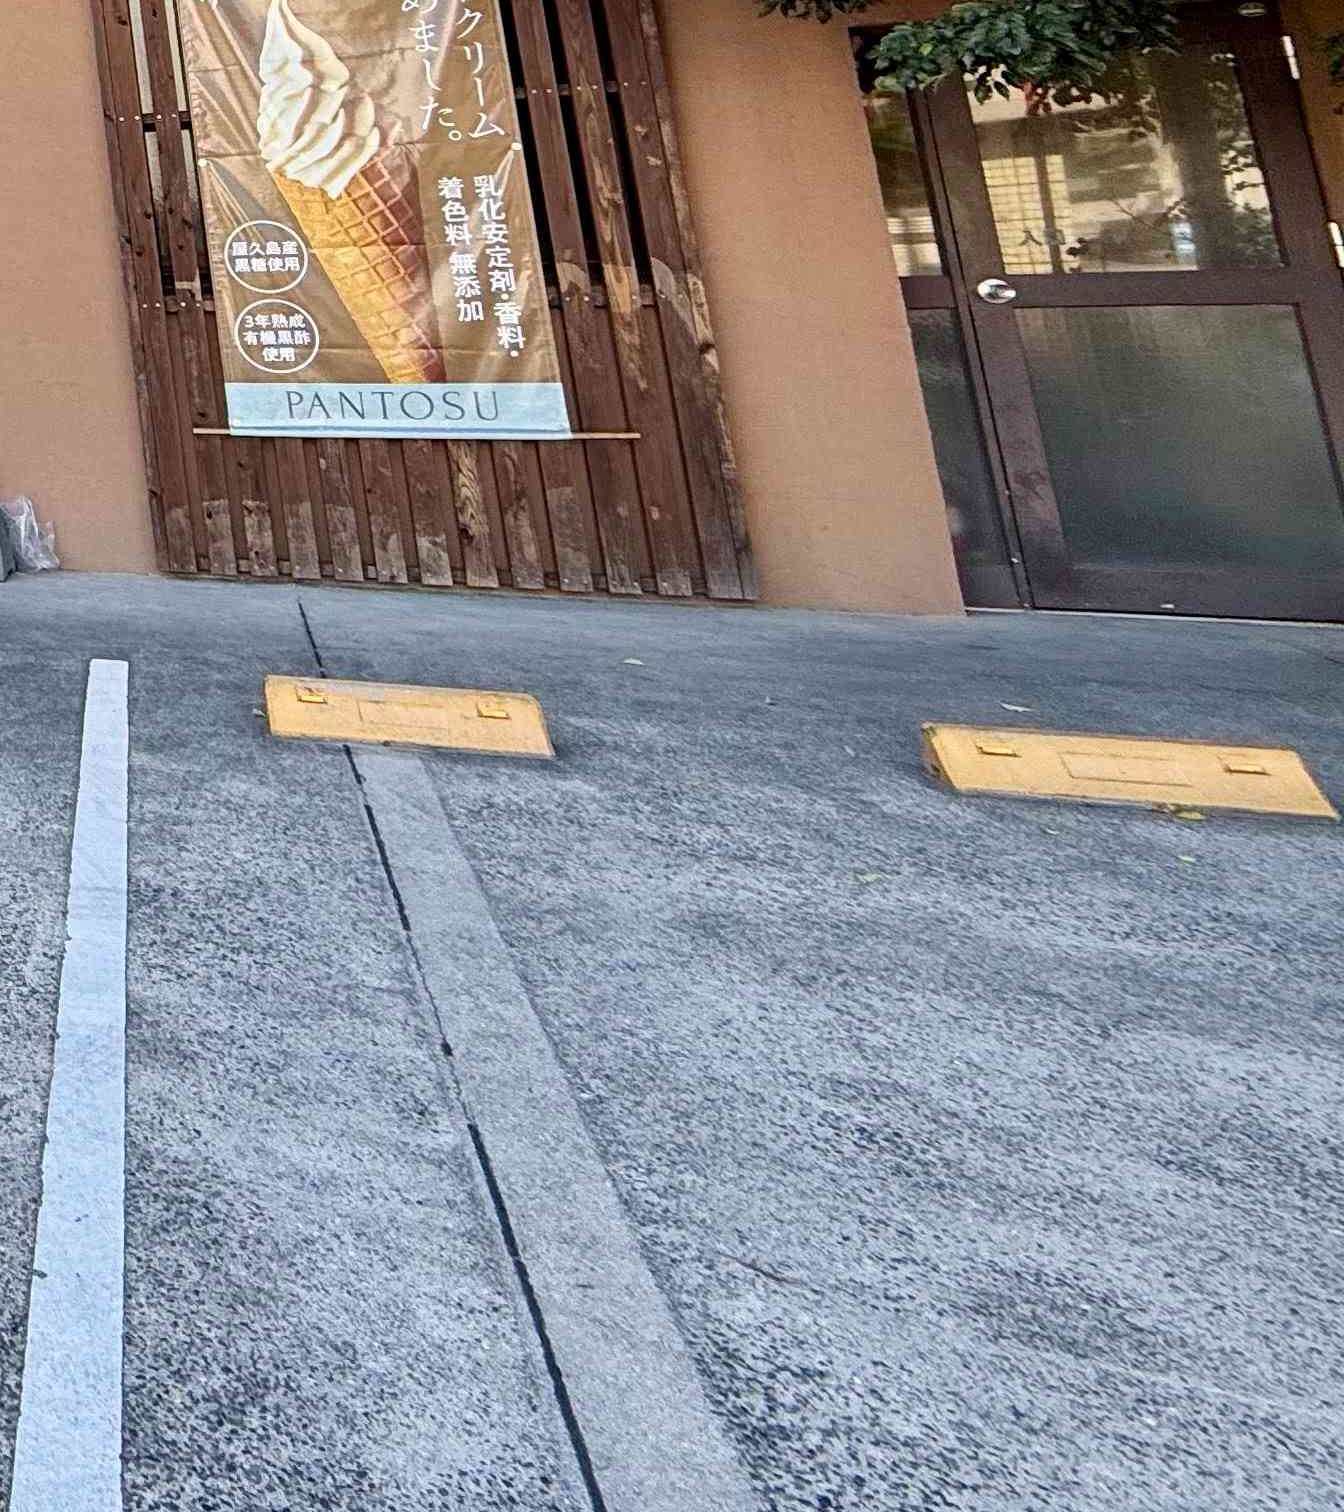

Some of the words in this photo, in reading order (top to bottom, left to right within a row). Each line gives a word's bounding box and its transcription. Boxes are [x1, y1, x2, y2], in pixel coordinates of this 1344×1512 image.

[232, 241, 298, 256] 屋久島産
[244, 313, 305, 328] 3年熟成
[242, 330, 311, 346] 有機黒酢
[263, 347, 296, 362] 使用
[286, 390, 499, 422] PANTOSU
